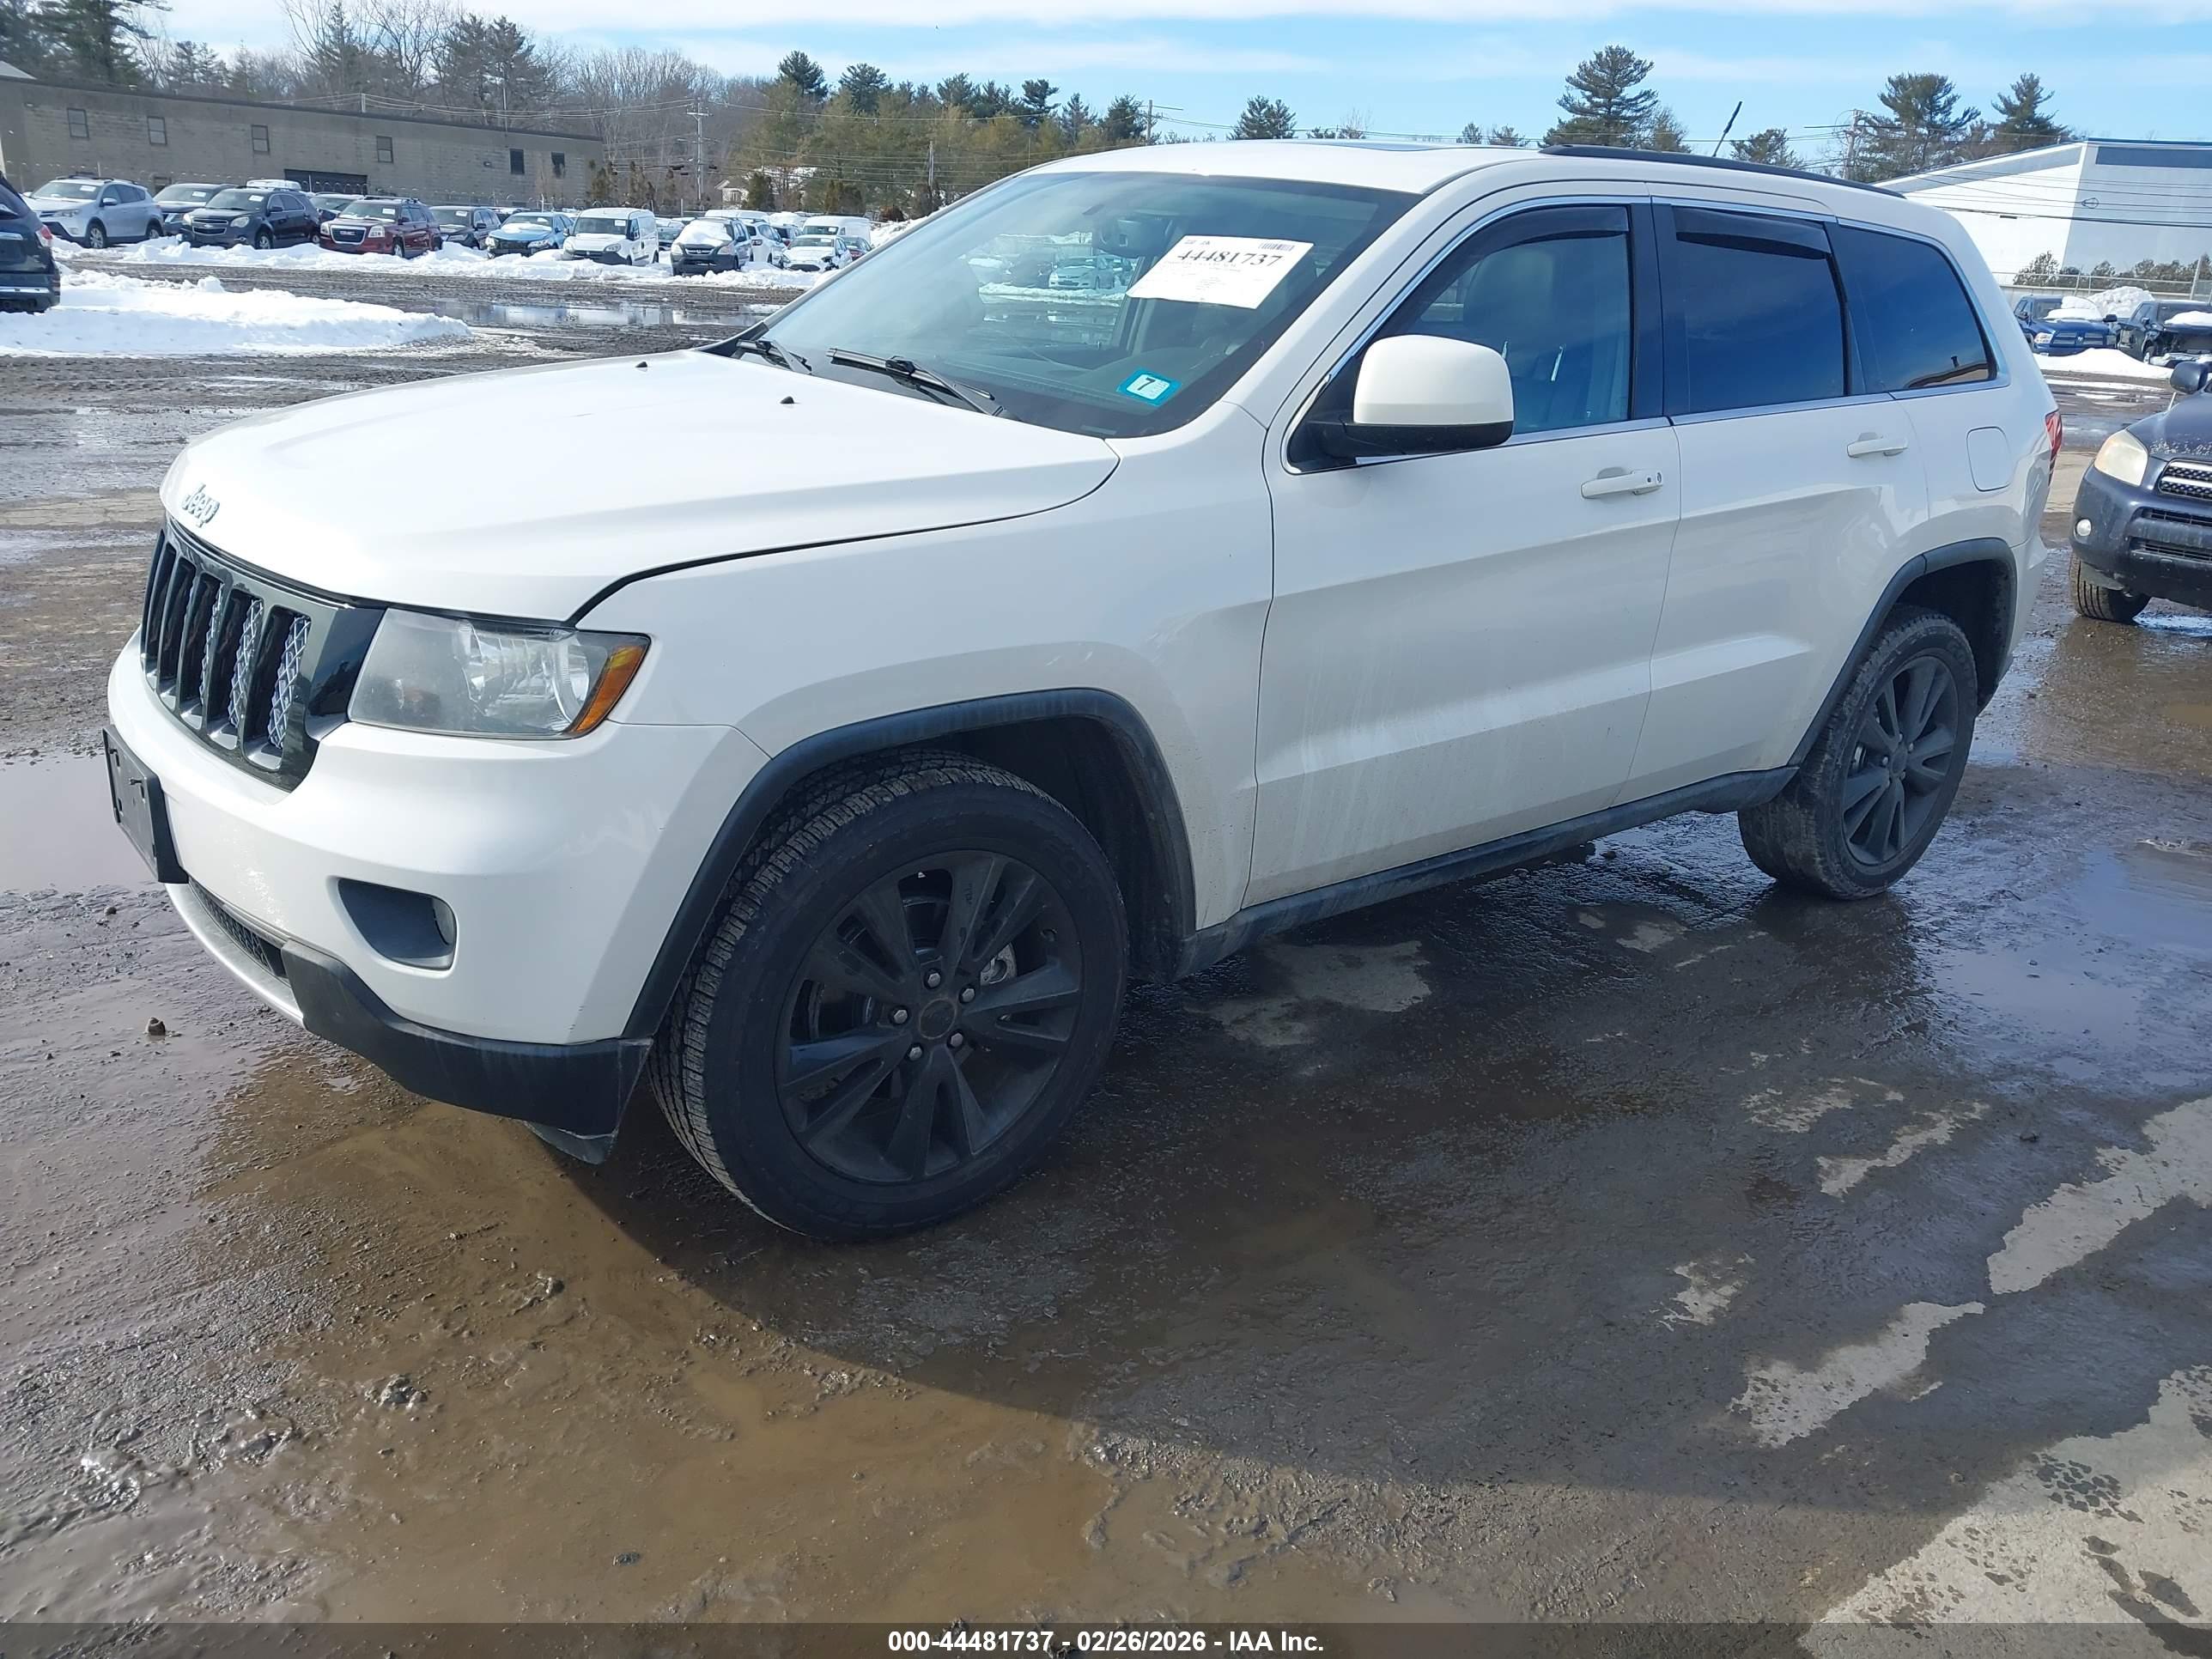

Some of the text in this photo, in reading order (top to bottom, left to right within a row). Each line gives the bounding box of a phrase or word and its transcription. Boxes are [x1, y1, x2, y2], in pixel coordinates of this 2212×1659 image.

[1177, 250, 1284, 267] 44481737
[1137, 377, 1157, 392] 7
[182, 483, 221, 528] Jeep
